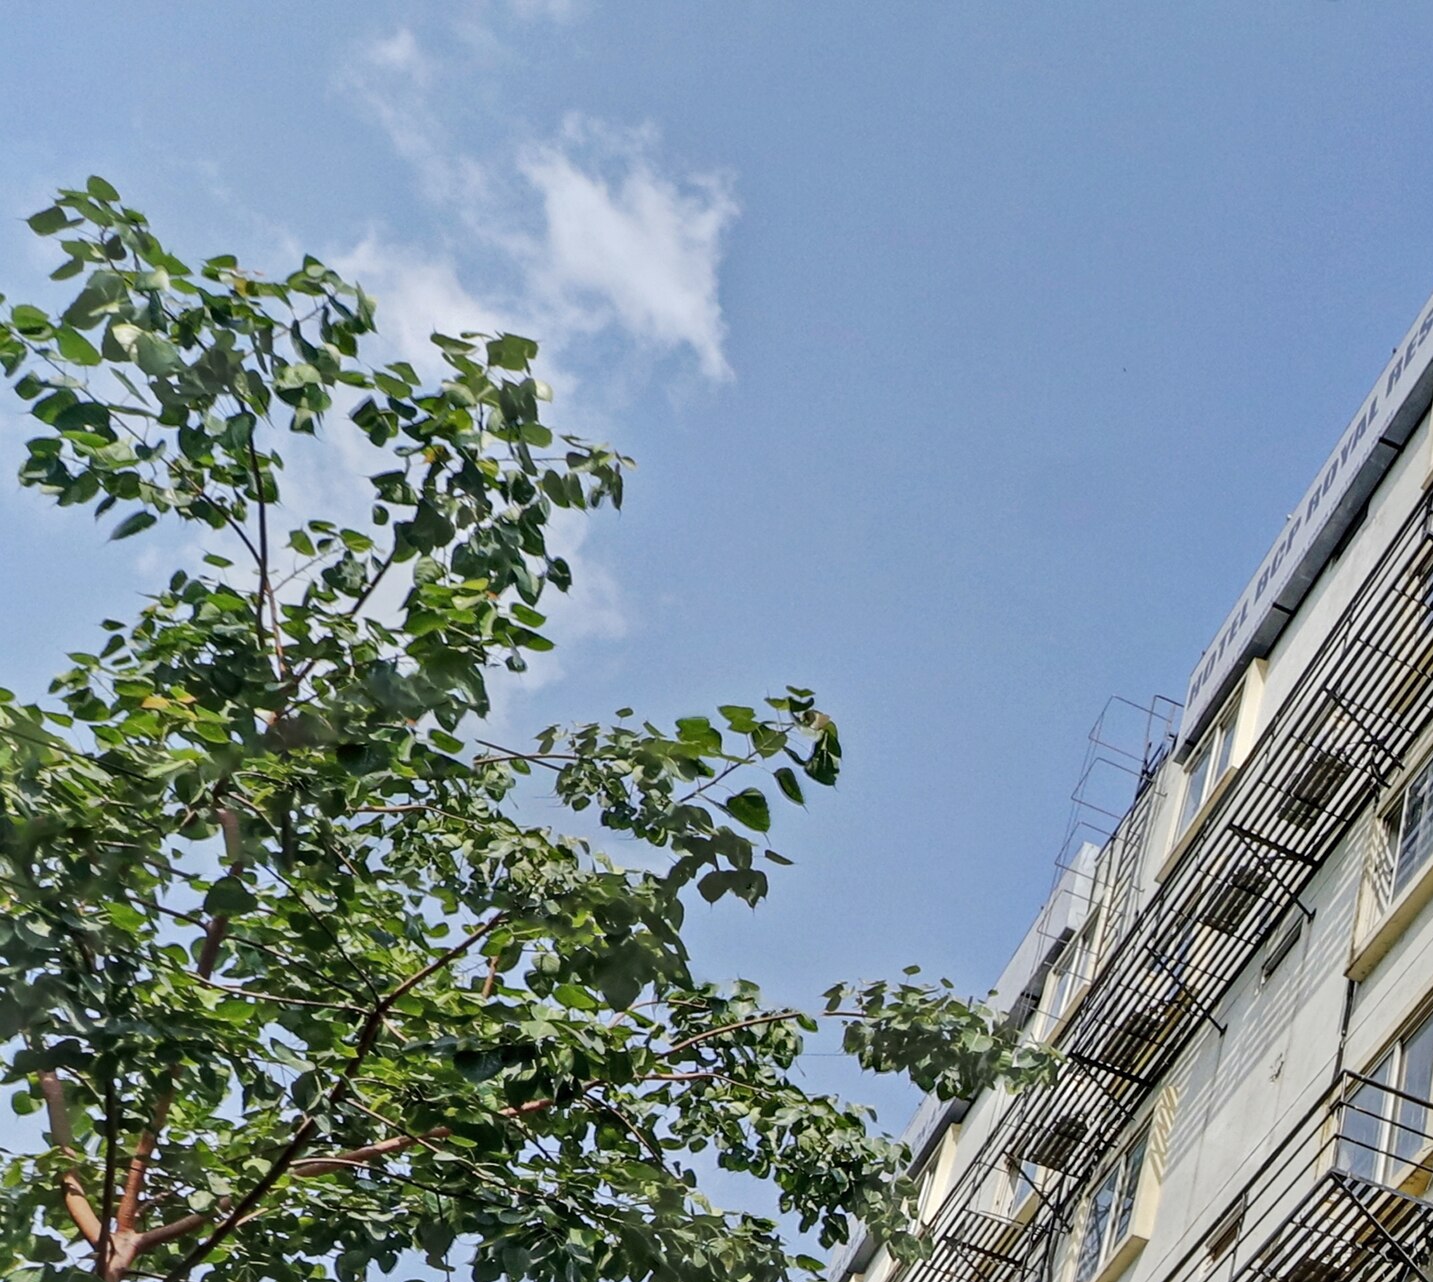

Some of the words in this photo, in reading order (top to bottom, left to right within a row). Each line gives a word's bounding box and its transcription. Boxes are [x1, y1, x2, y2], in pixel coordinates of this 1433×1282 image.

[1187, 598, 1249, 711] HOTEL
[1254, 516, 1302, 605] BCP
[1305, 395, 1379, 526] ROYAL
